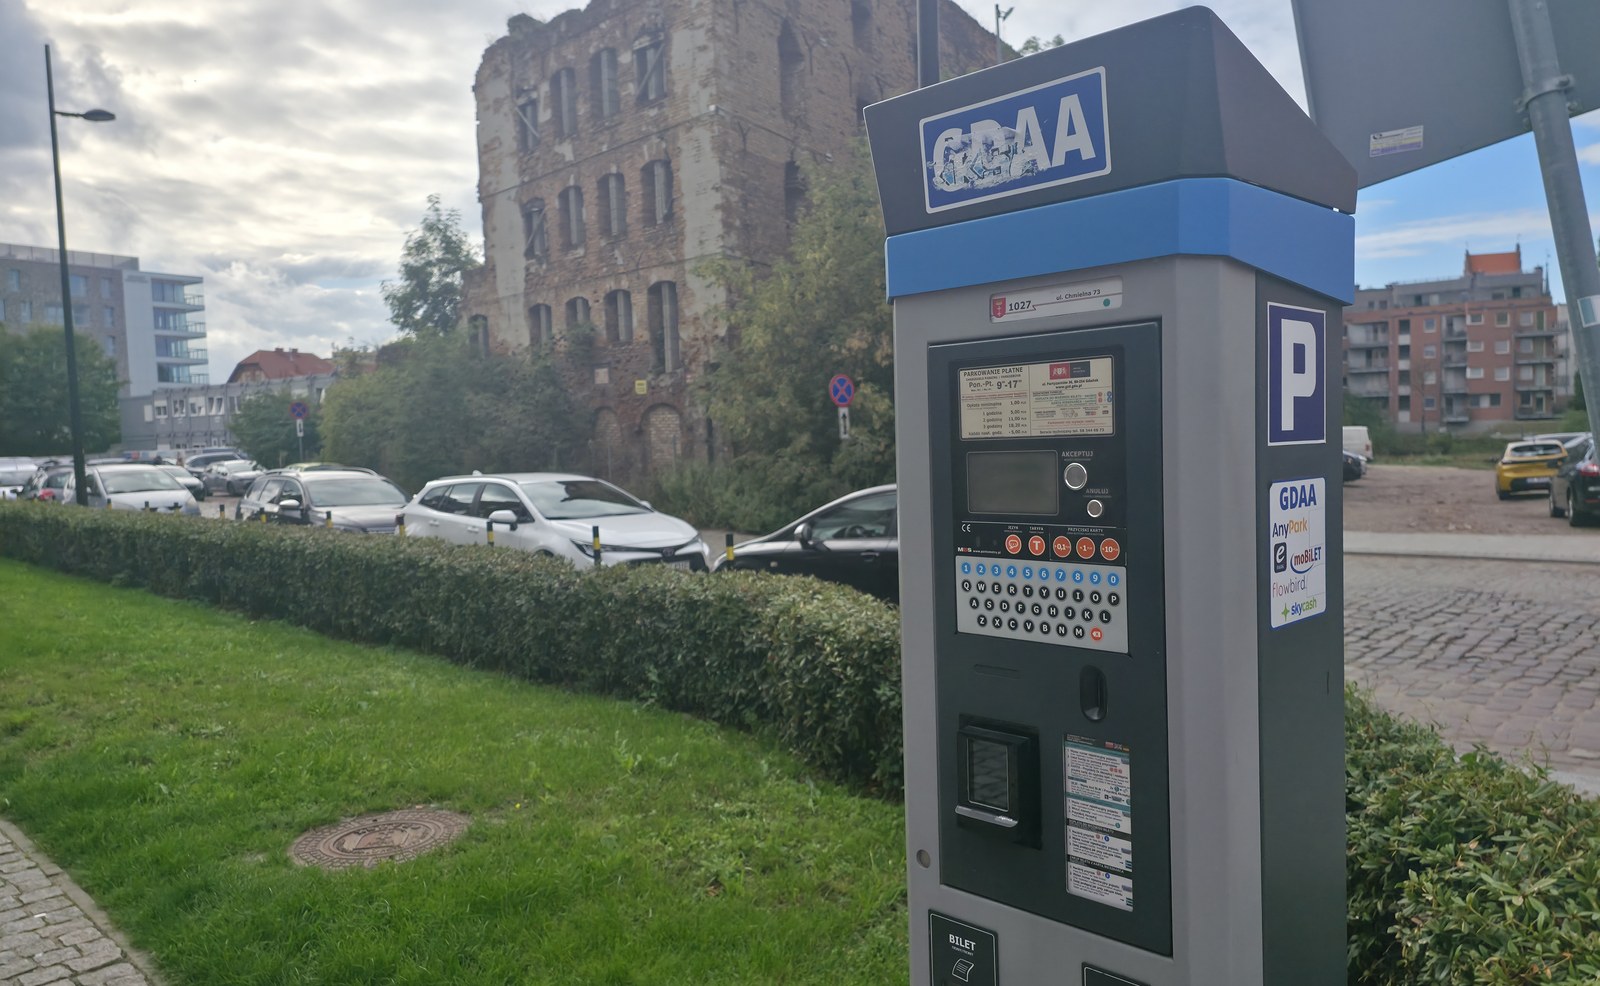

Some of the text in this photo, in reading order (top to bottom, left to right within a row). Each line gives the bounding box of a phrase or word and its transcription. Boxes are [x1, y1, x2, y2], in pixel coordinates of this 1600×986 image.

[1064, 290, 1091, 299] Chmielna
[1008, 300, 1032, 311] 1027
[964, 368, 1000, 377] PARKOWANIE
[1282, 318, 1316, 431] P
[1280, 484, 1317, 510] GDAA
[1272, 518, 1308, 538] AnyPark
[1033, 541, 1041, 550] T
[963, 582, 970, 590] Q
[1291, 597, 1317, 616] skycash
[949, 934, 976, 951] BILET
